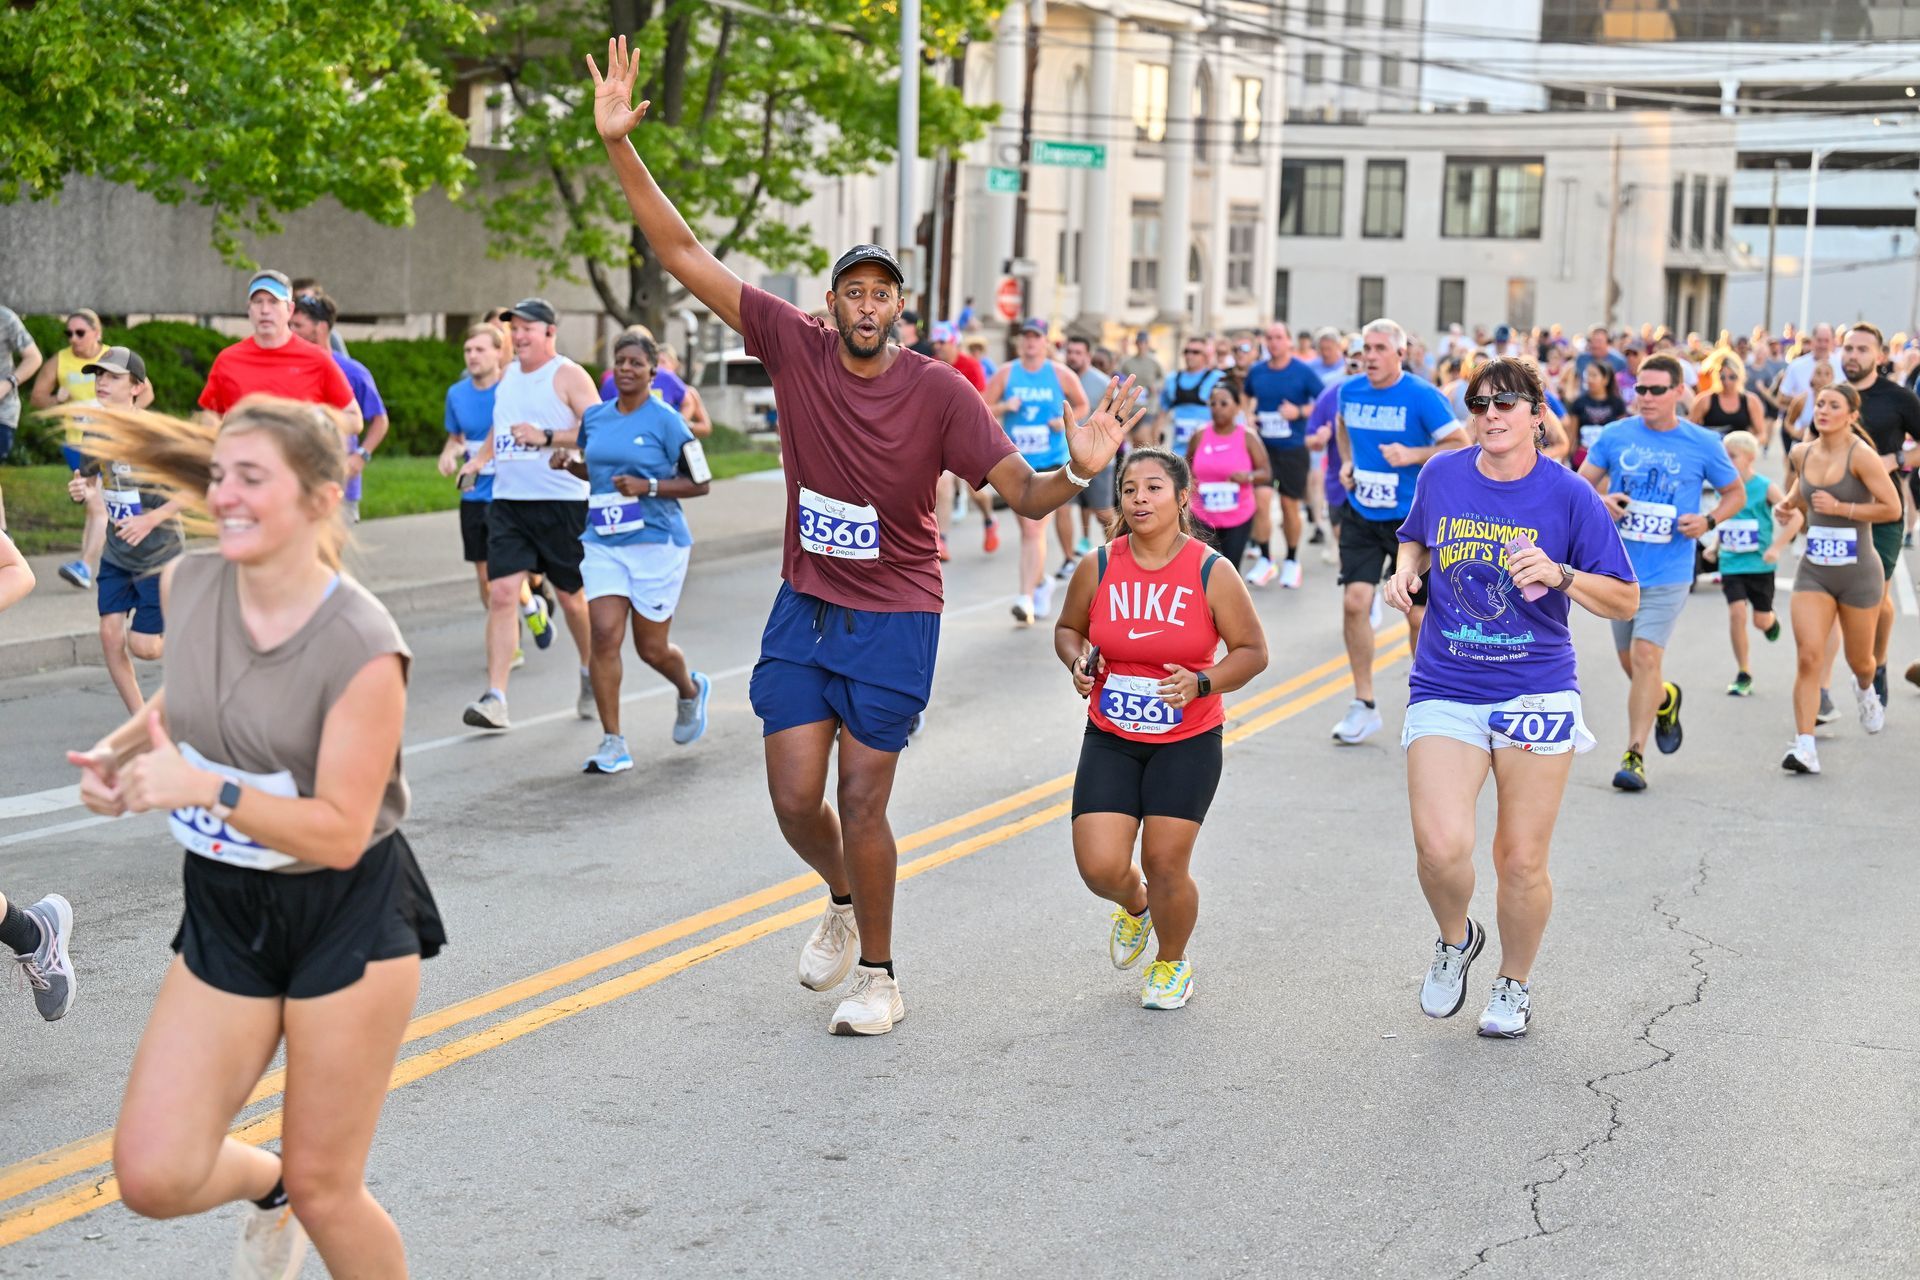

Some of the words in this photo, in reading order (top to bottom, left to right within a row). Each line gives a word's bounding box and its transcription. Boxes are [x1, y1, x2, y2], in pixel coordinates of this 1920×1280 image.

[1012, 387, 1054, 402] TEAM
[601, 506, 623, 525] 19
[1484, 515, 1516, 525] ANNUAL
[1621, 511, 1672, 535] 3398
[800, 509, 876, 548] 3560
[1436, 516, 1447, 545] A
[1439, 541, 1493, 573] NIGHT'S
[1811, 539, 1848, 557] 388
[1109, 581, 1194, 627] NIKE
[1485, 654, 1508, 663] Joseph
[1509, 651, 1529, 660] Health
[1106, 692, 1175, 723] 3561
[1141, 724, 1161, 732] pepsi
[1503, 713, 1567, 741] 707
[1533, 743, 1554, 752] pepsi
